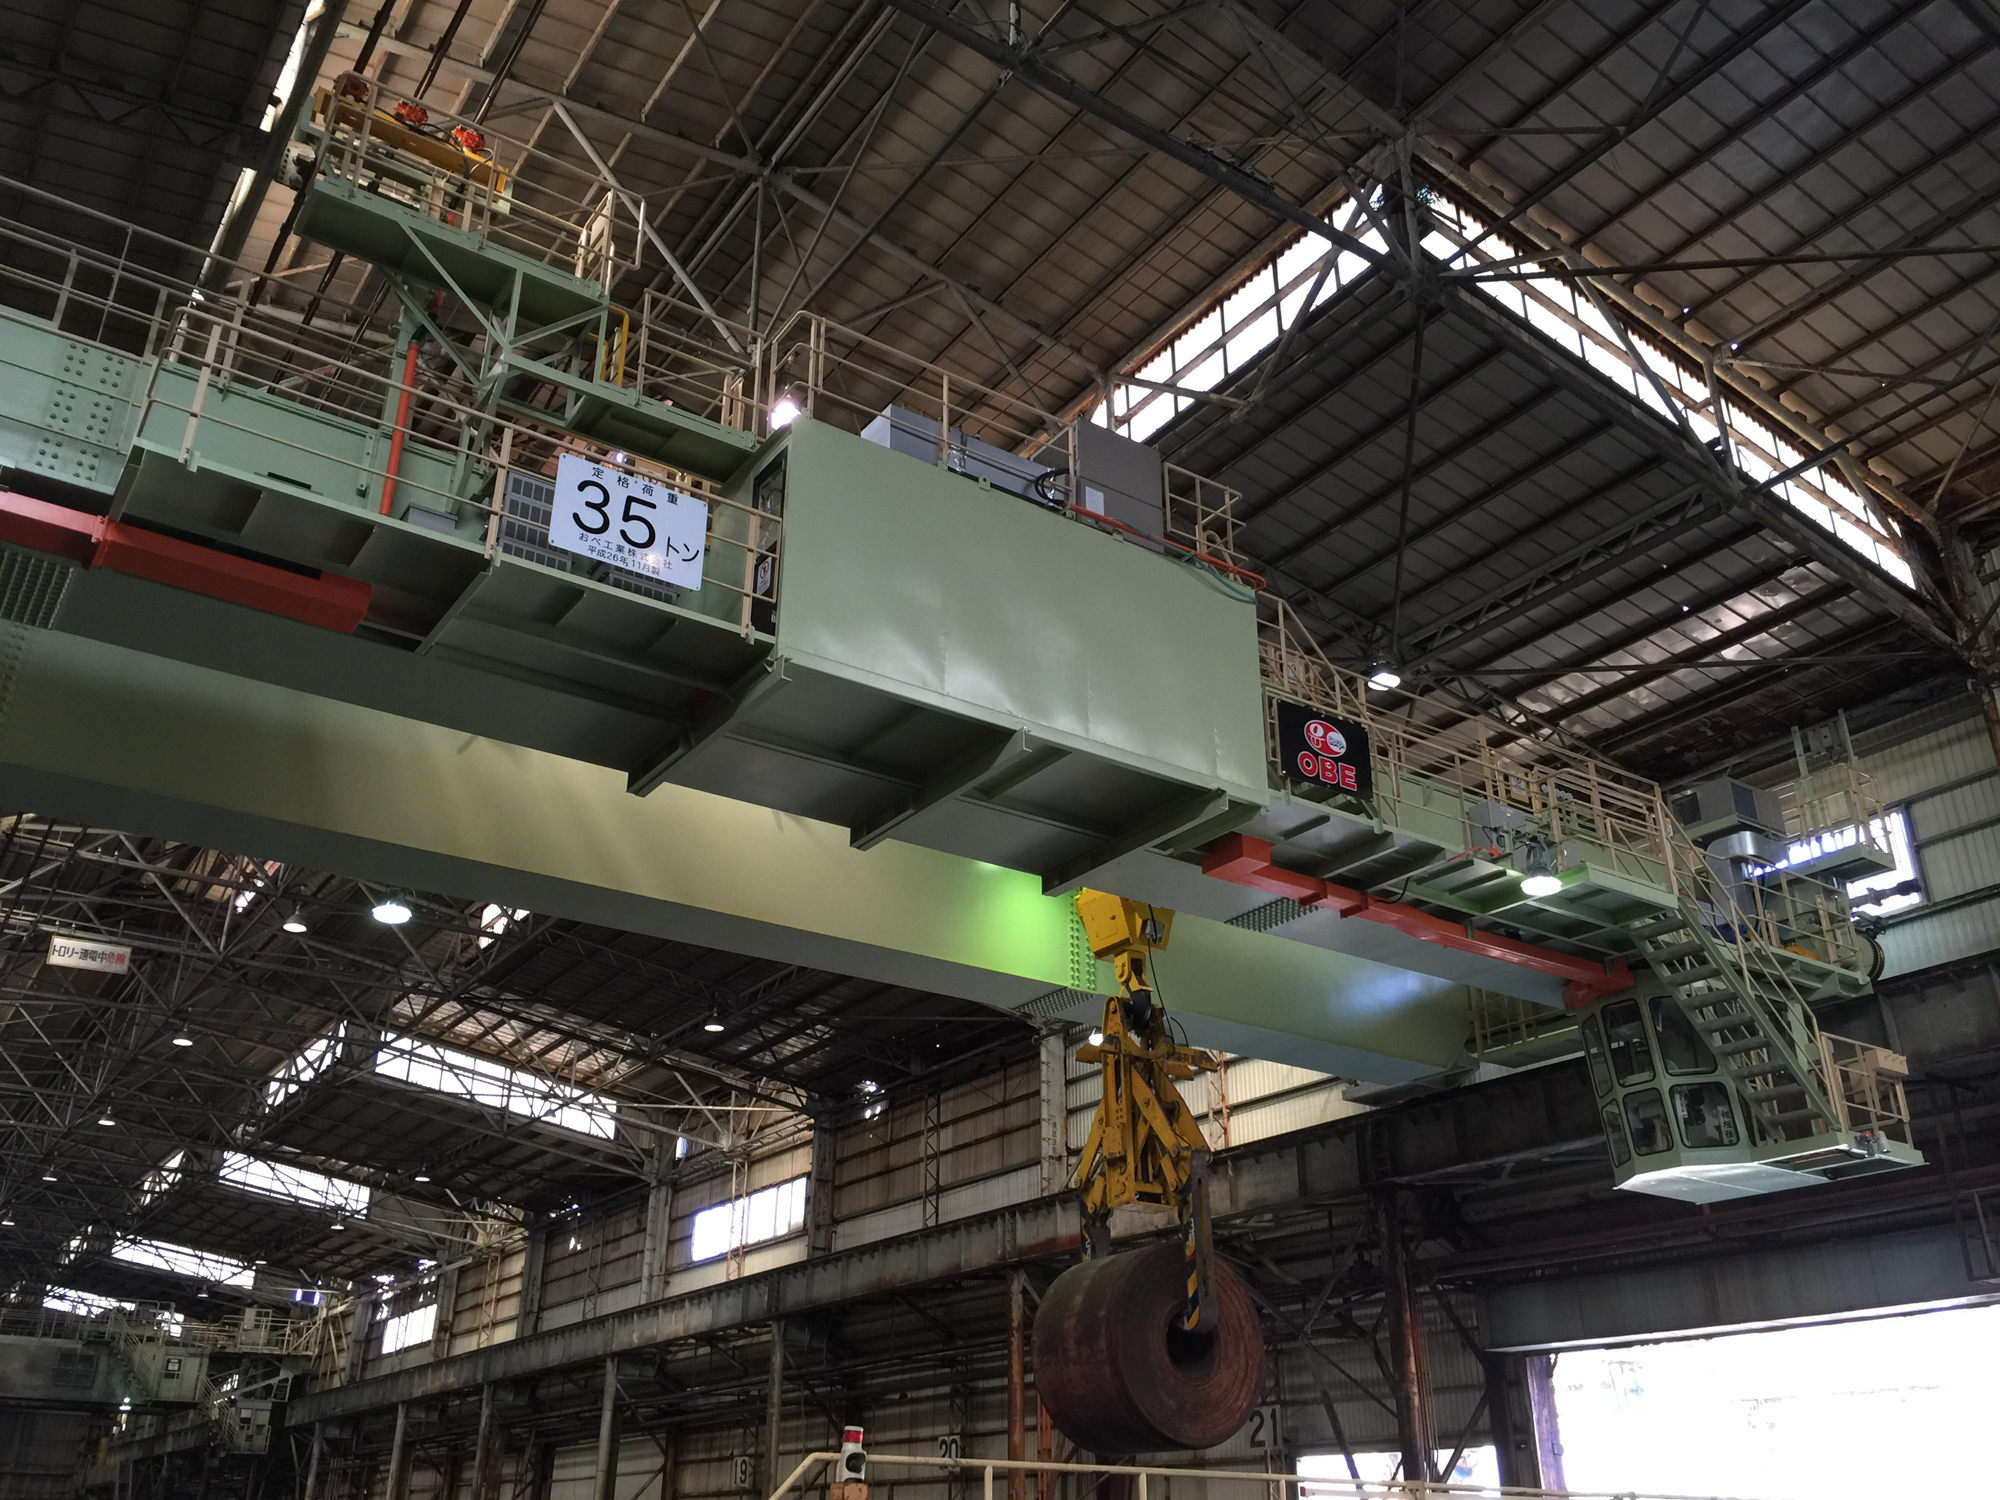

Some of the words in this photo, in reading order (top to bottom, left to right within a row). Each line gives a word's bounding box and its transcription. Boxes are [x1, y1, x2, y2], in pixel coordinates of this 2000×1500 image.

[591, 467, 679, 506] 定格荷重
[578, 532, 673, 570] おべ工業株式会社
[1297, 751, 1358, 791] OBE
[51, 944, 127, 965] トロリー通電中危険
[1249, 1408, 1278, 1448] 21
[734, 1458, 747, 1485] 19
[939, 1438, 958, 1470] 20
